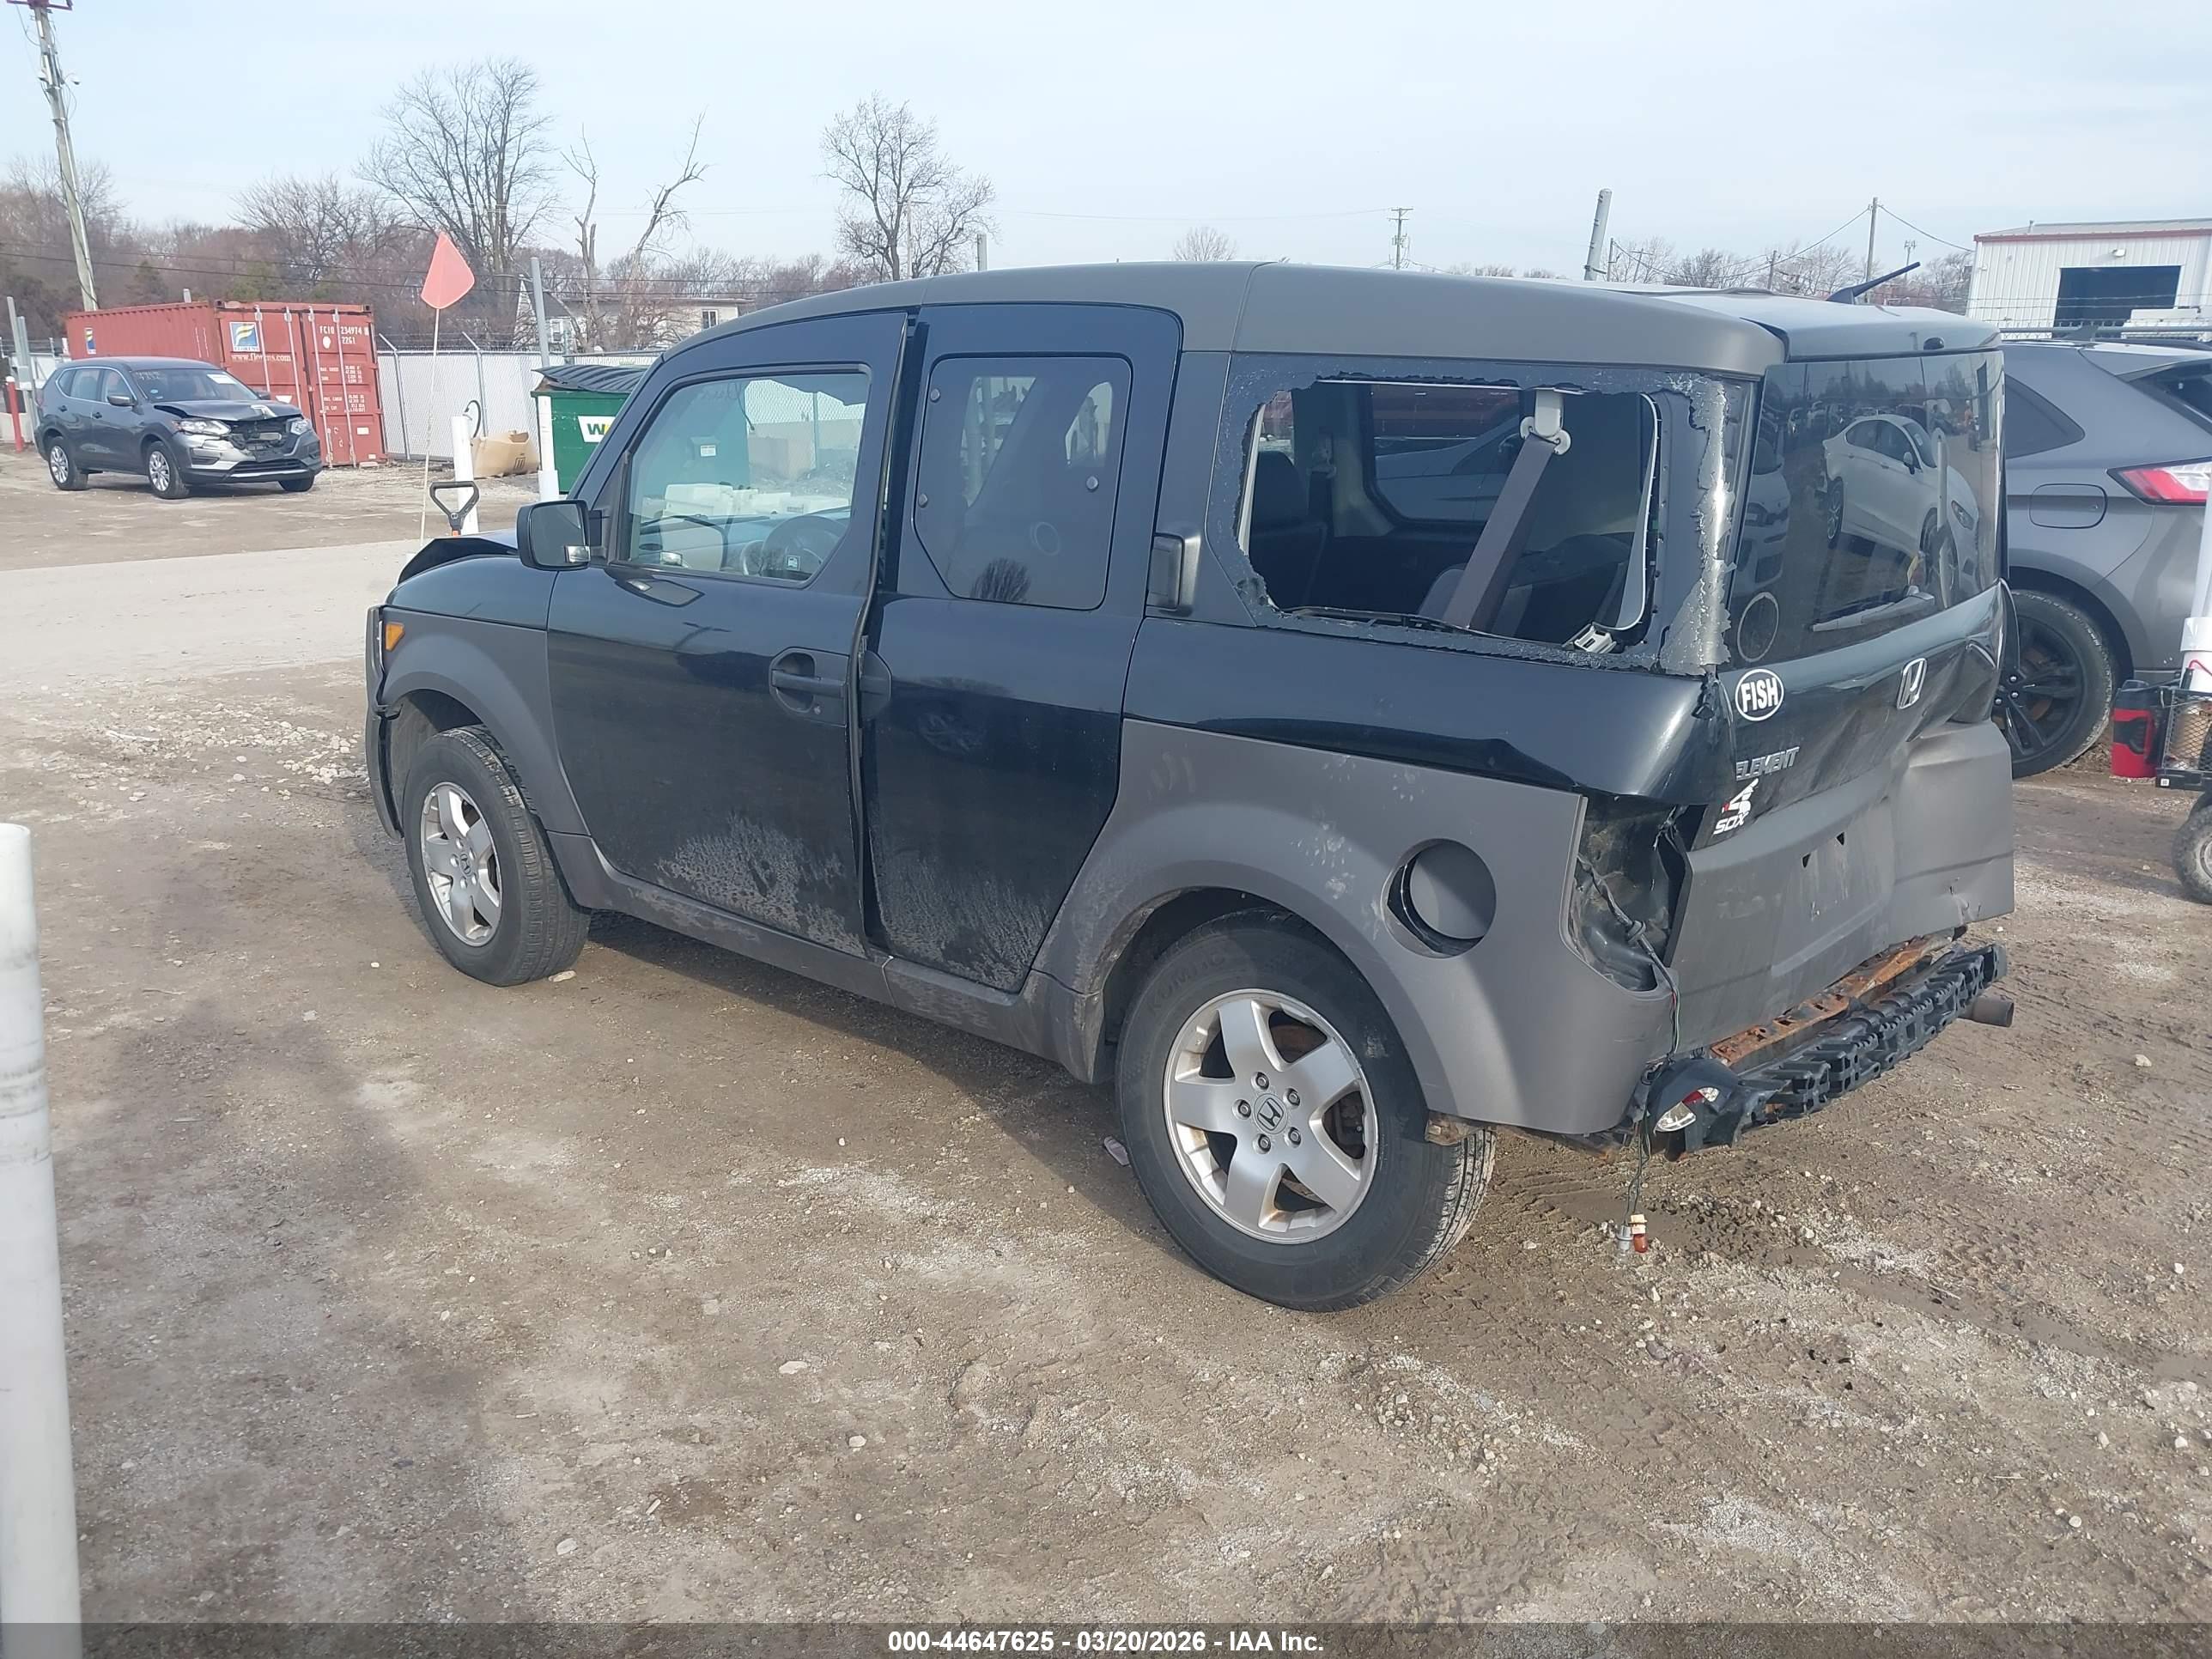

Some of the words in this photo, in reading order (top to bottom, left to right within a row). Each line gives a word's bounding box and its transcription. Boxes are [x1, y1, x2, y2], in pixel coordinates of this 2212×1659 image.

[1741, 677, 1779, 713] FISH
[1735, 746, 1801, 781] ELEMENT
[1713, 811, 1750, 835] SOX
